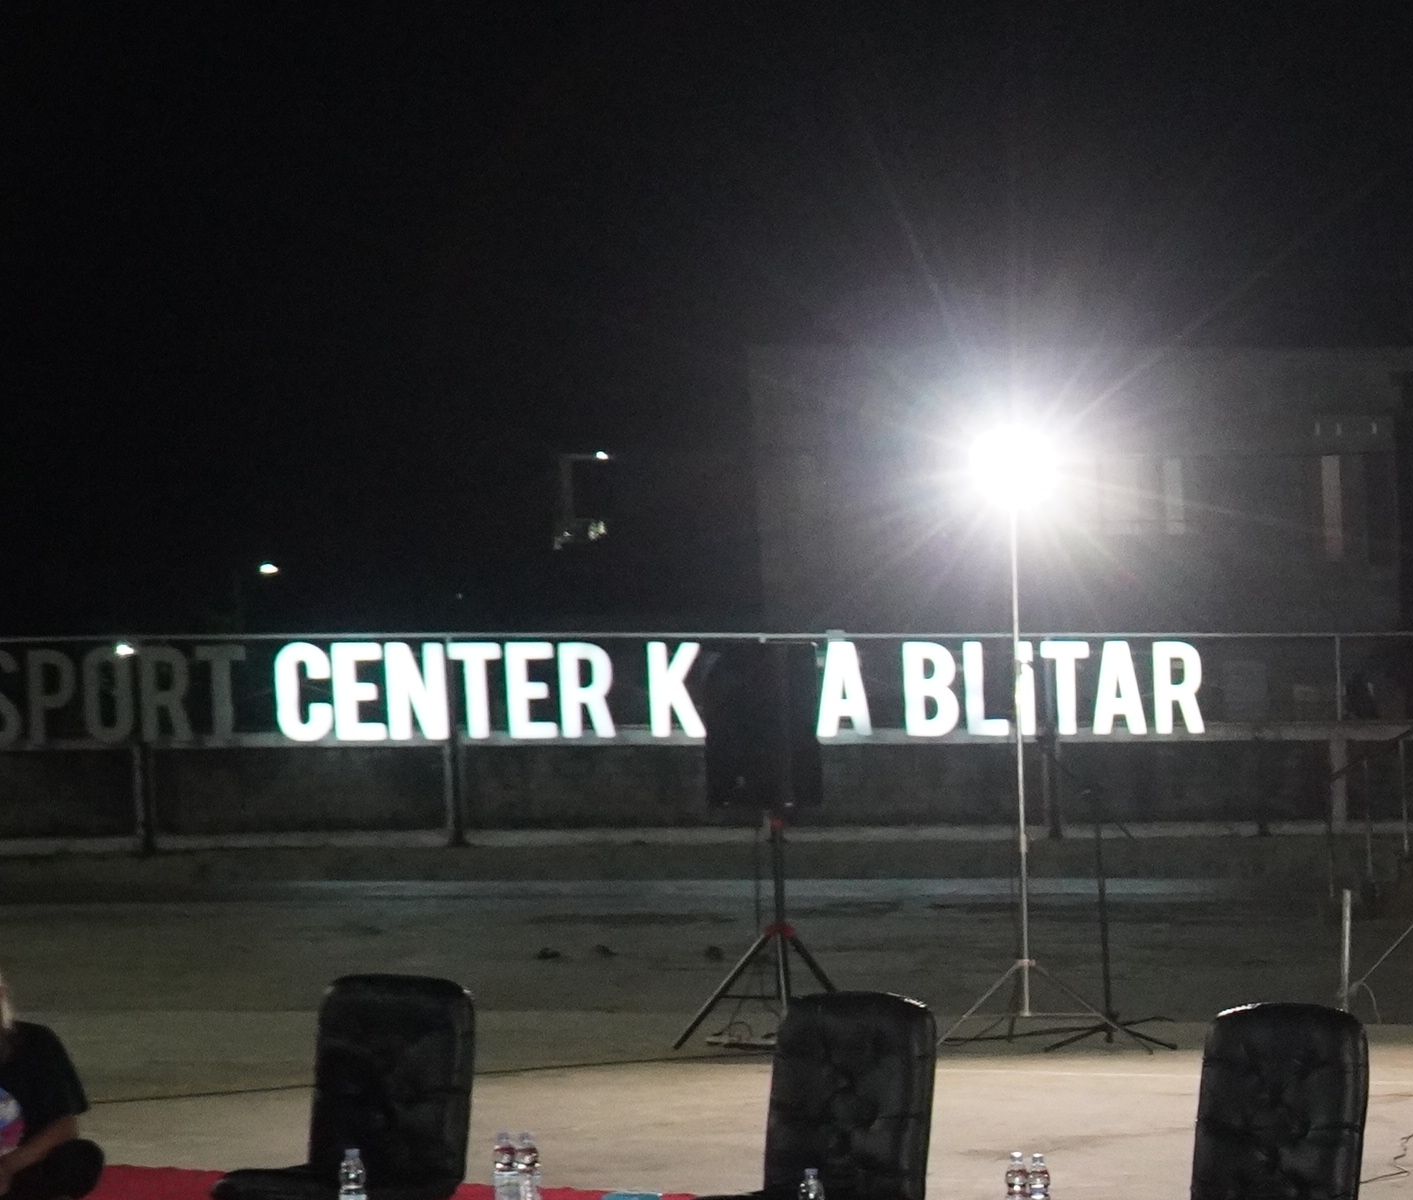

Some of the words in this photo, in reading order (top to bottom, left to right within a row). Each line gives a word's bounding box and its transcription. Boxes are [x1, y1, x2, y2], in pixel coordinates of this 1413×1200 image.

[0, 643, 246, 746] SPORT
[274, 641, 616, 742] CENTER
[648, 641, 872, 740] KA
[901, 640, 1206, 738] BLITAR
